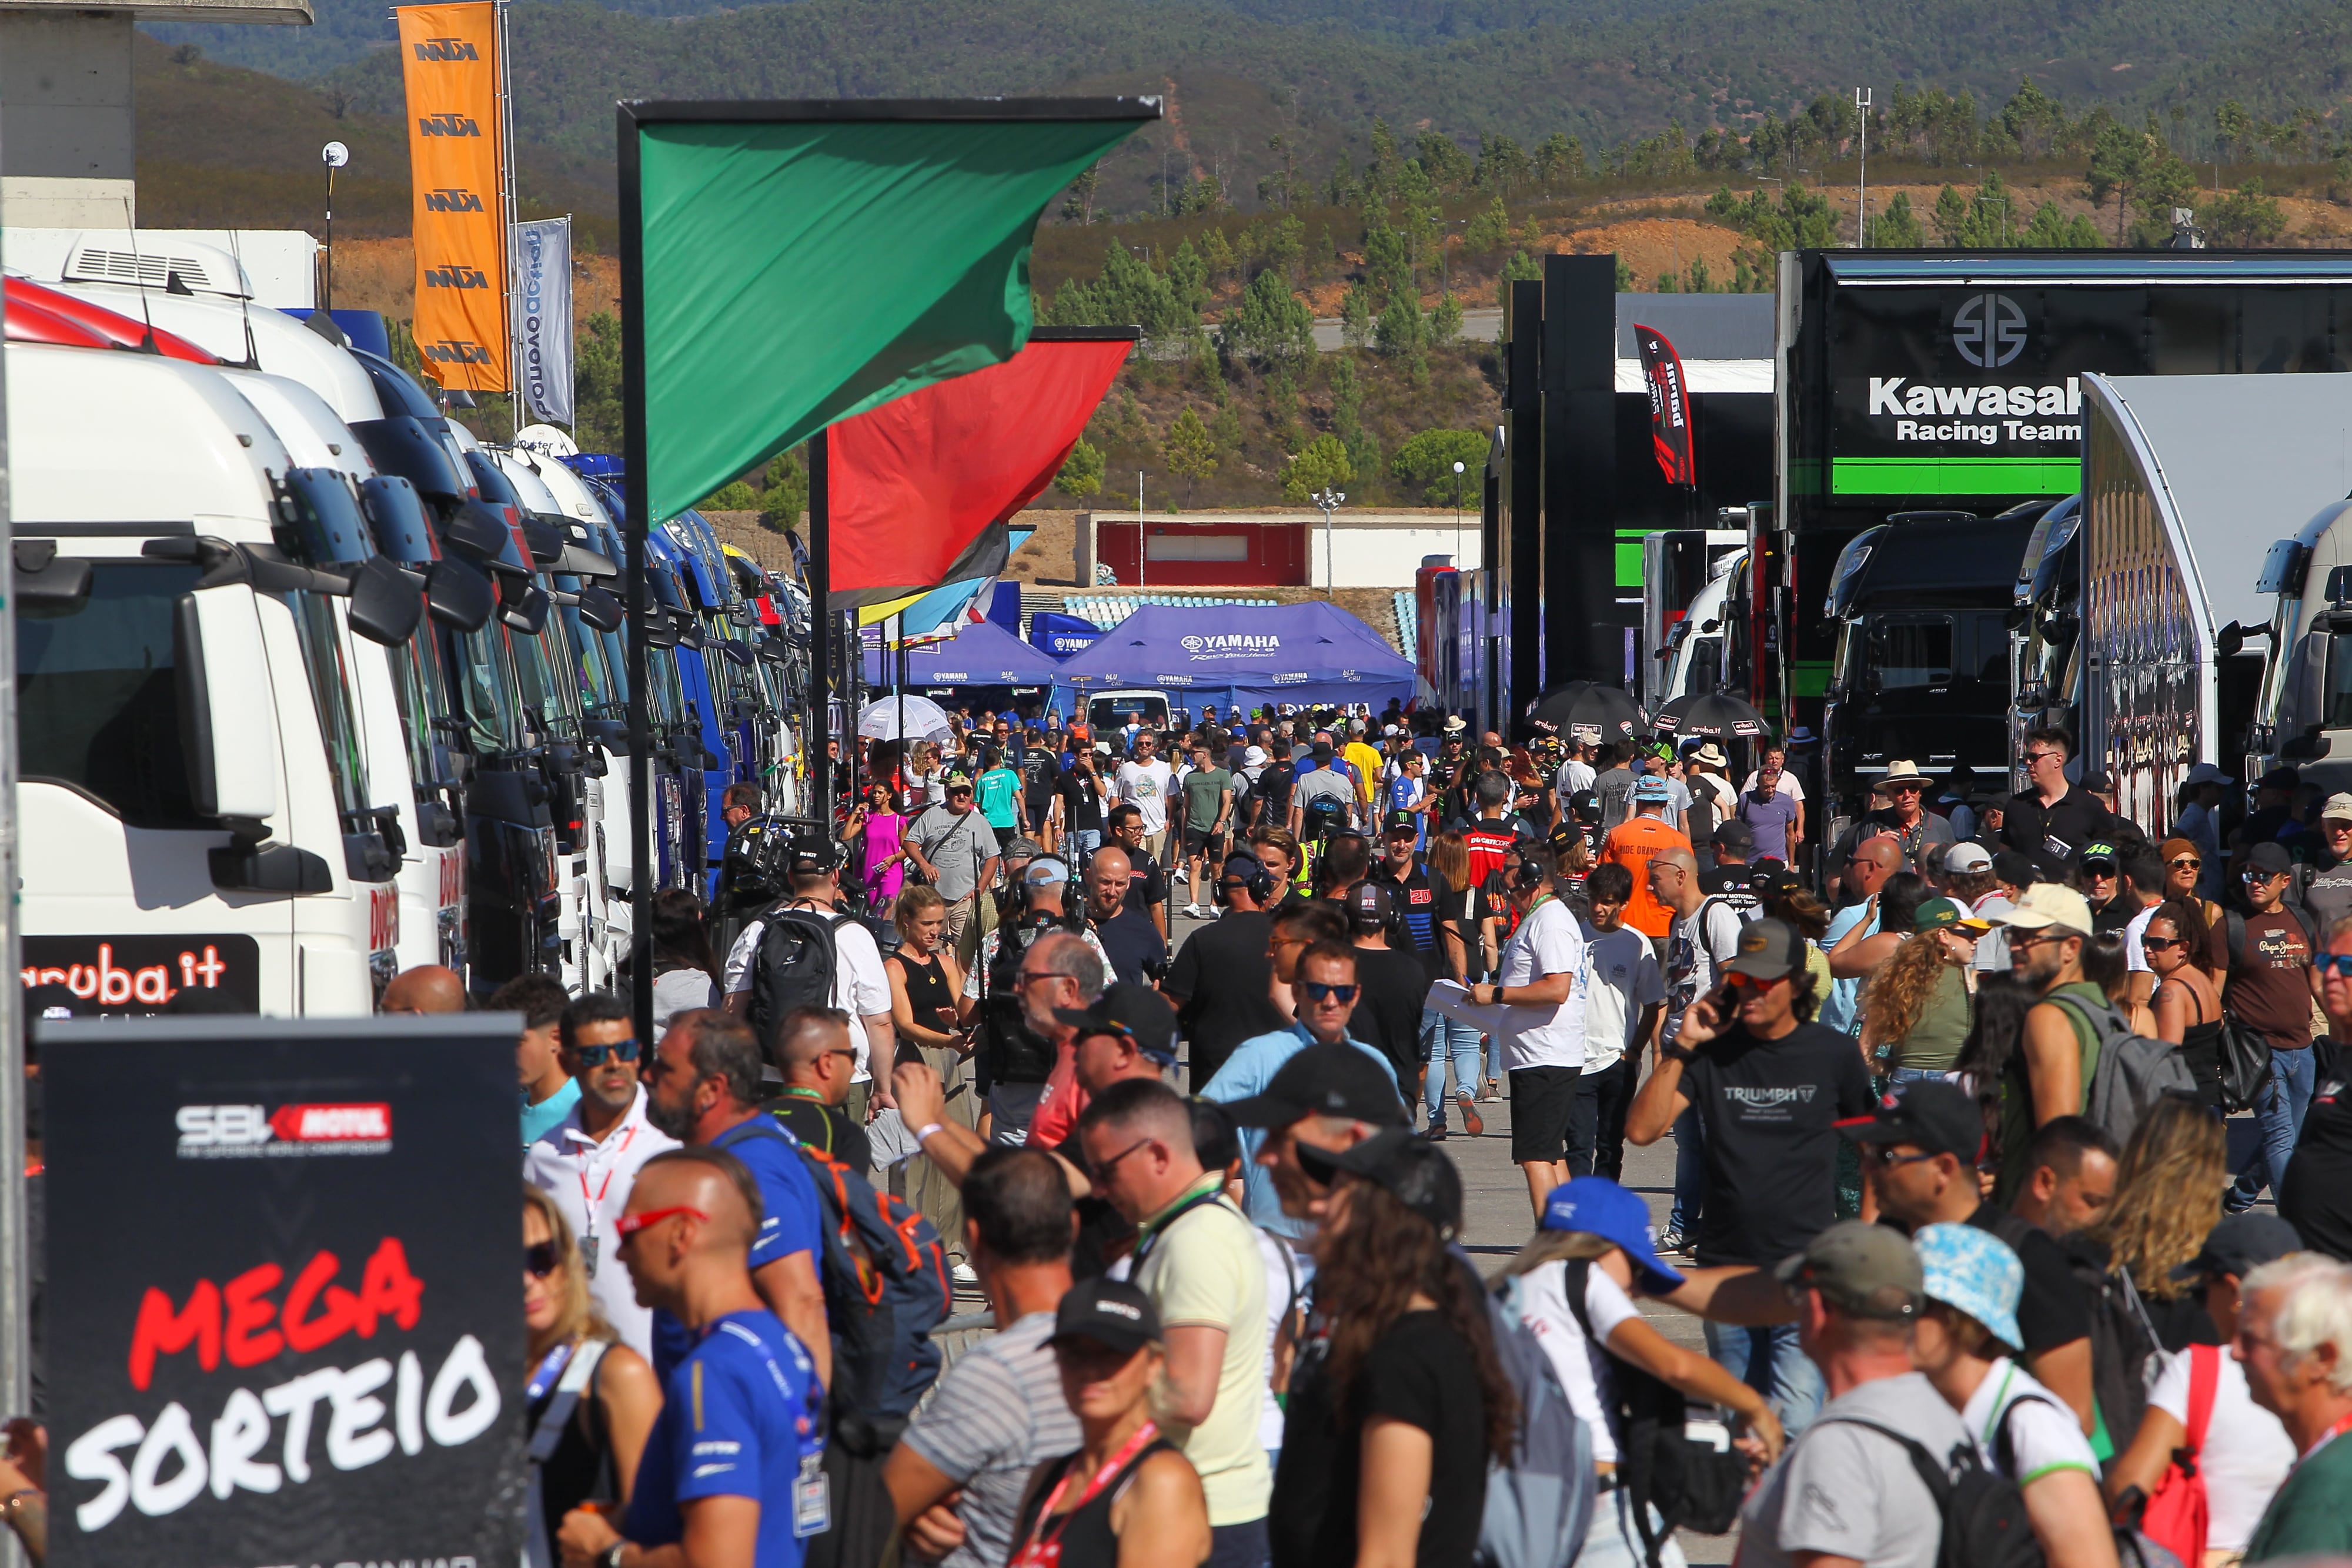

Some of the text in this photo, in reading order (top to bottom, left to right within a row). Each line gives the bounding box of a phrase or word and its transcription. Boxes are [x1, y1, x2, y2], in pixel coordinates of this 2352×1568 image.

[1896, 420, 2081, 445] Racing Team
[520, 439, 554, 450] Oyster
[1204, 635, 1281, 648] YAMAHA
[1165, 674, 1192, 683] YAMAHA
[1280, 672, 1308, 681] YAMAHA
[1690, 725, 1722, 734] aruba.it
[2084, 843, 2114, 855] 46
[1409, 888, 1432, 904] 20
[2259, 940, 2304, 954] Pepe Jeans
[1724, 1086, 1798, 1107] TRIUMPH
[298, 1107, 388, 1139] MOTUL
[127, 1236, 425, 1392] MEGA
[64, 1333, 502, 1533] SORTEIO
